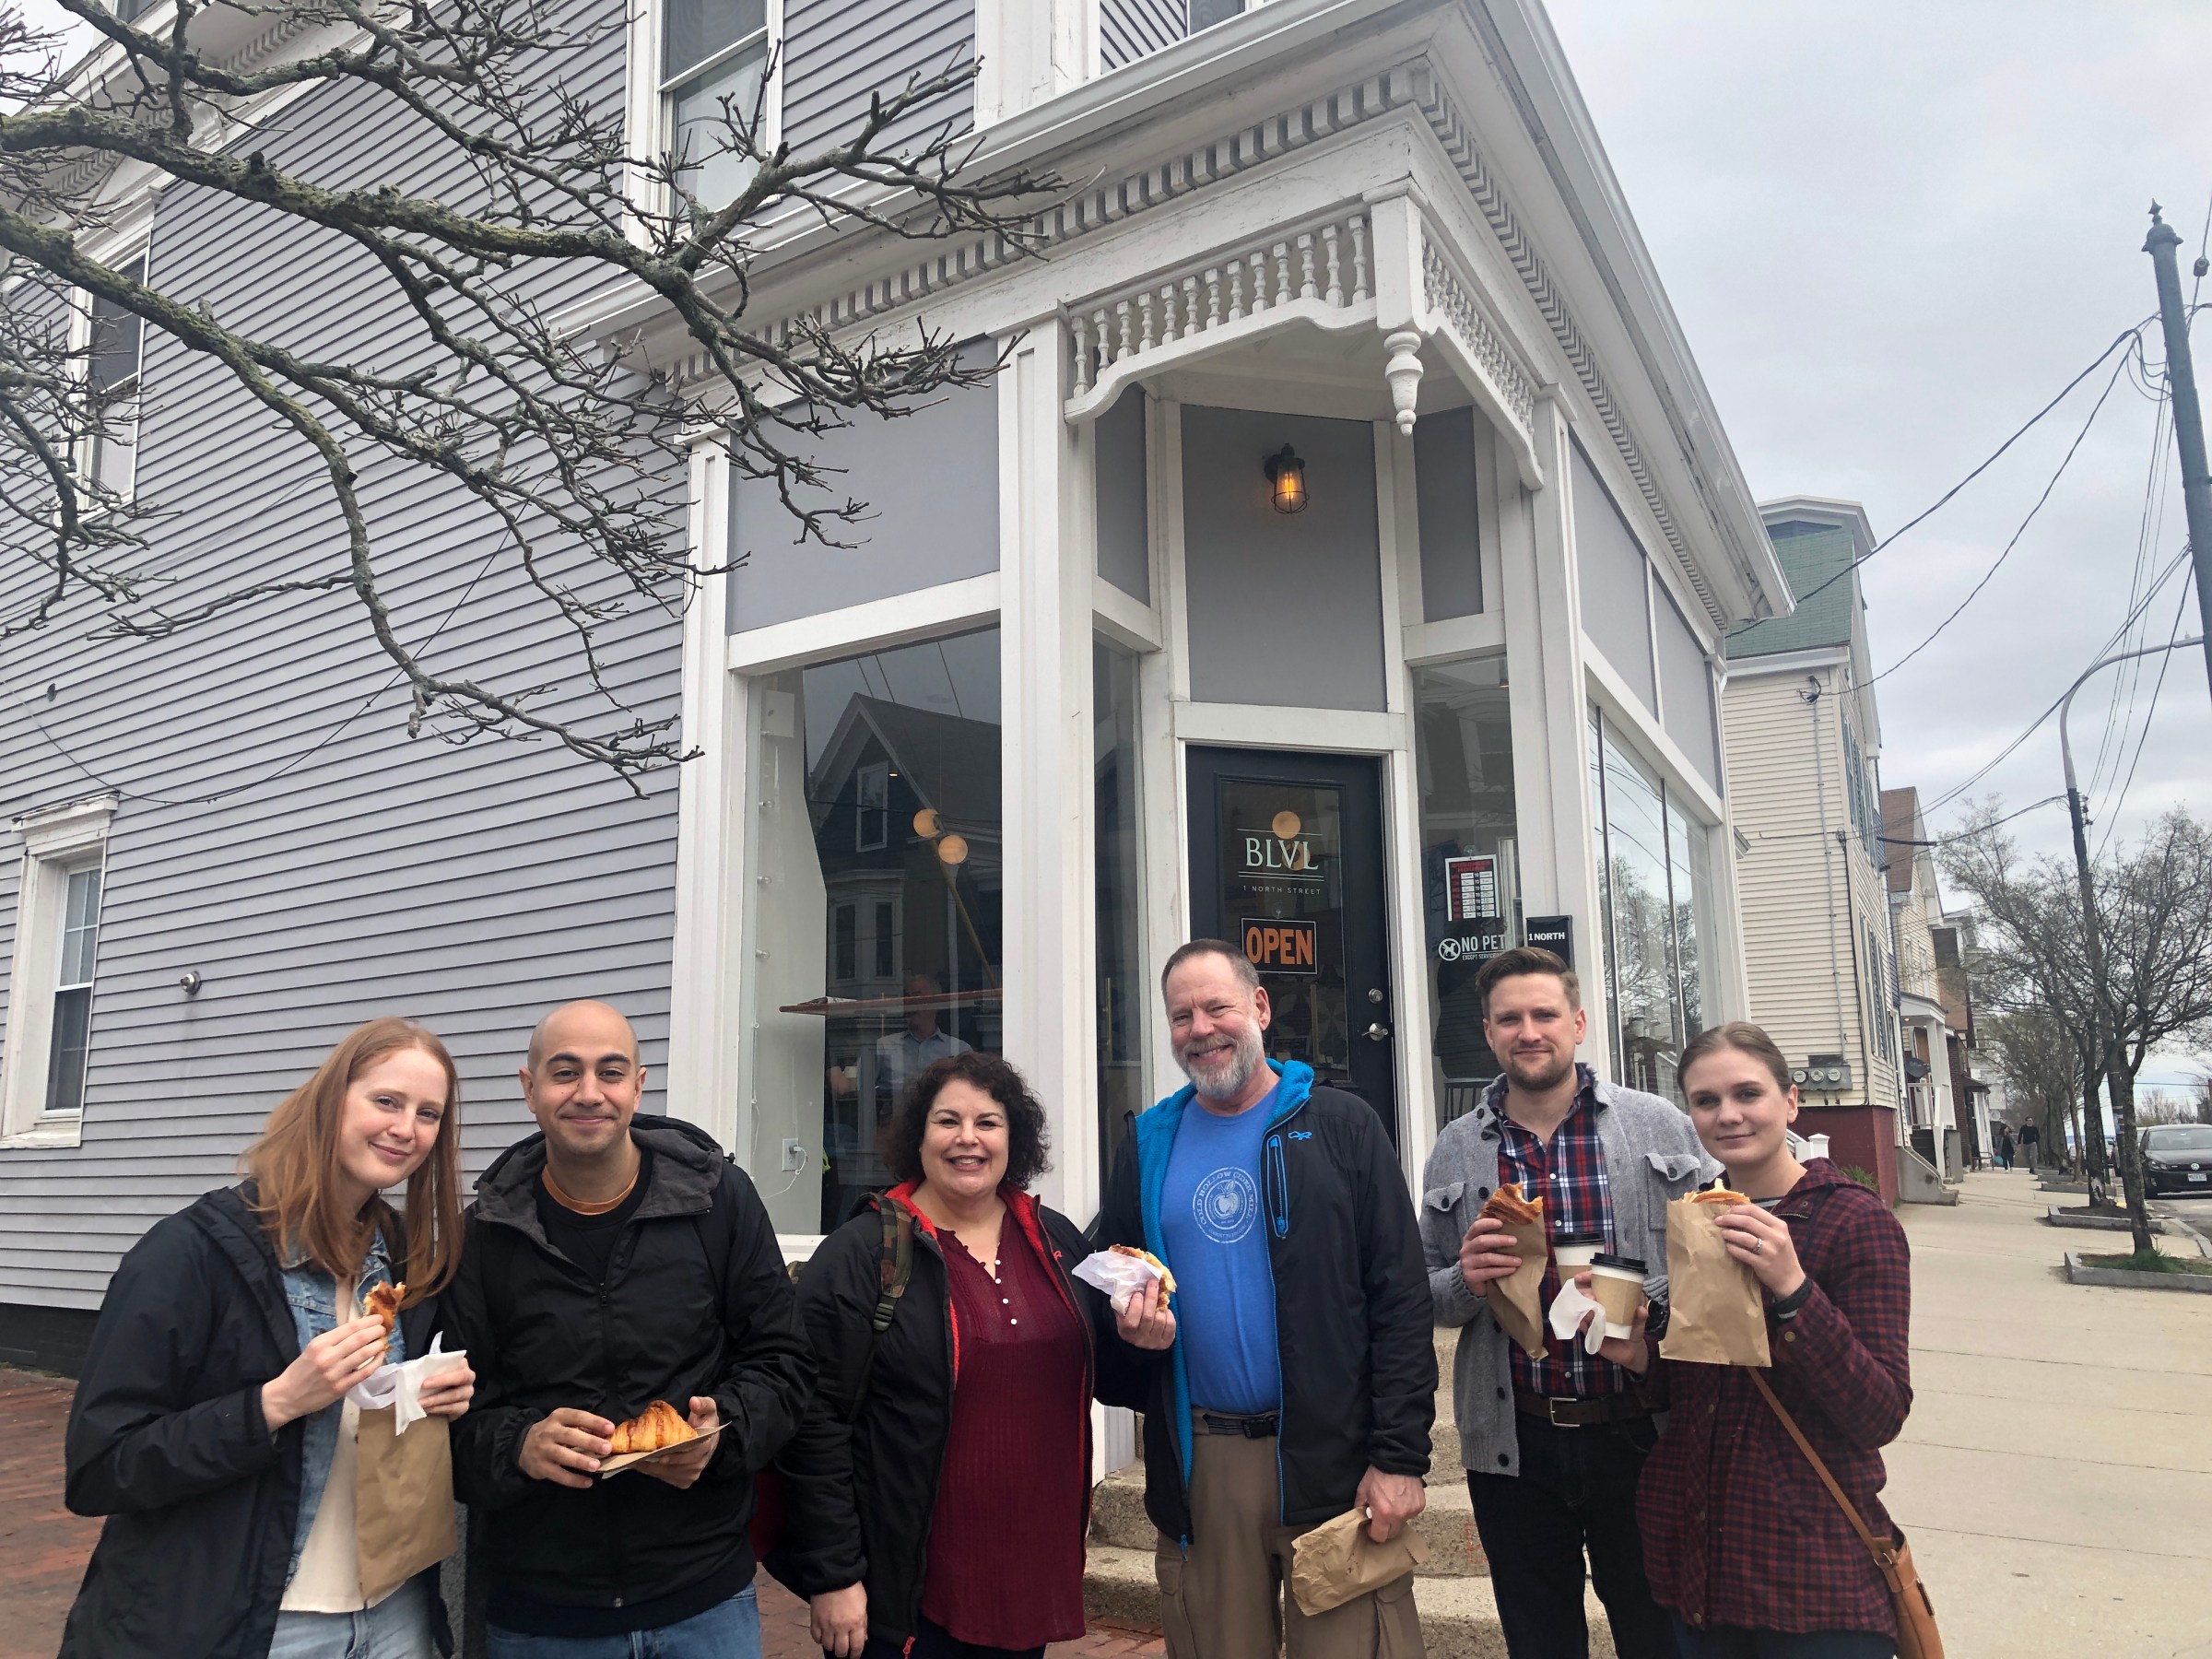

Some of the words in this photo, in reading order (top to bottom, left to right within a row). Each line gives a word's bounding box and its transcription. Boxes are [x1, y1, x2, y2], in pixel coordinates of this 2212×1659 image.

[1246, 837, 1319, 870] BLVL
[1287, 887, 1321, 895] STREET
[1246, 926, 1313, 965] OPEN
[1461, 935, 1478, 952] NO
[1482, 933, 1512, 951] PET
[1528, 933, 1534, 941] 1
[1534, 932, 1566, 941] NORTH
[1462, 953, 1477, 961] EXCEPT
[1198, 1171, 1231, 1197] HOLLOW
[1232, 1171, 1253, 1193] CIDER
[1196, 1198, 1207, 1225] COLD
